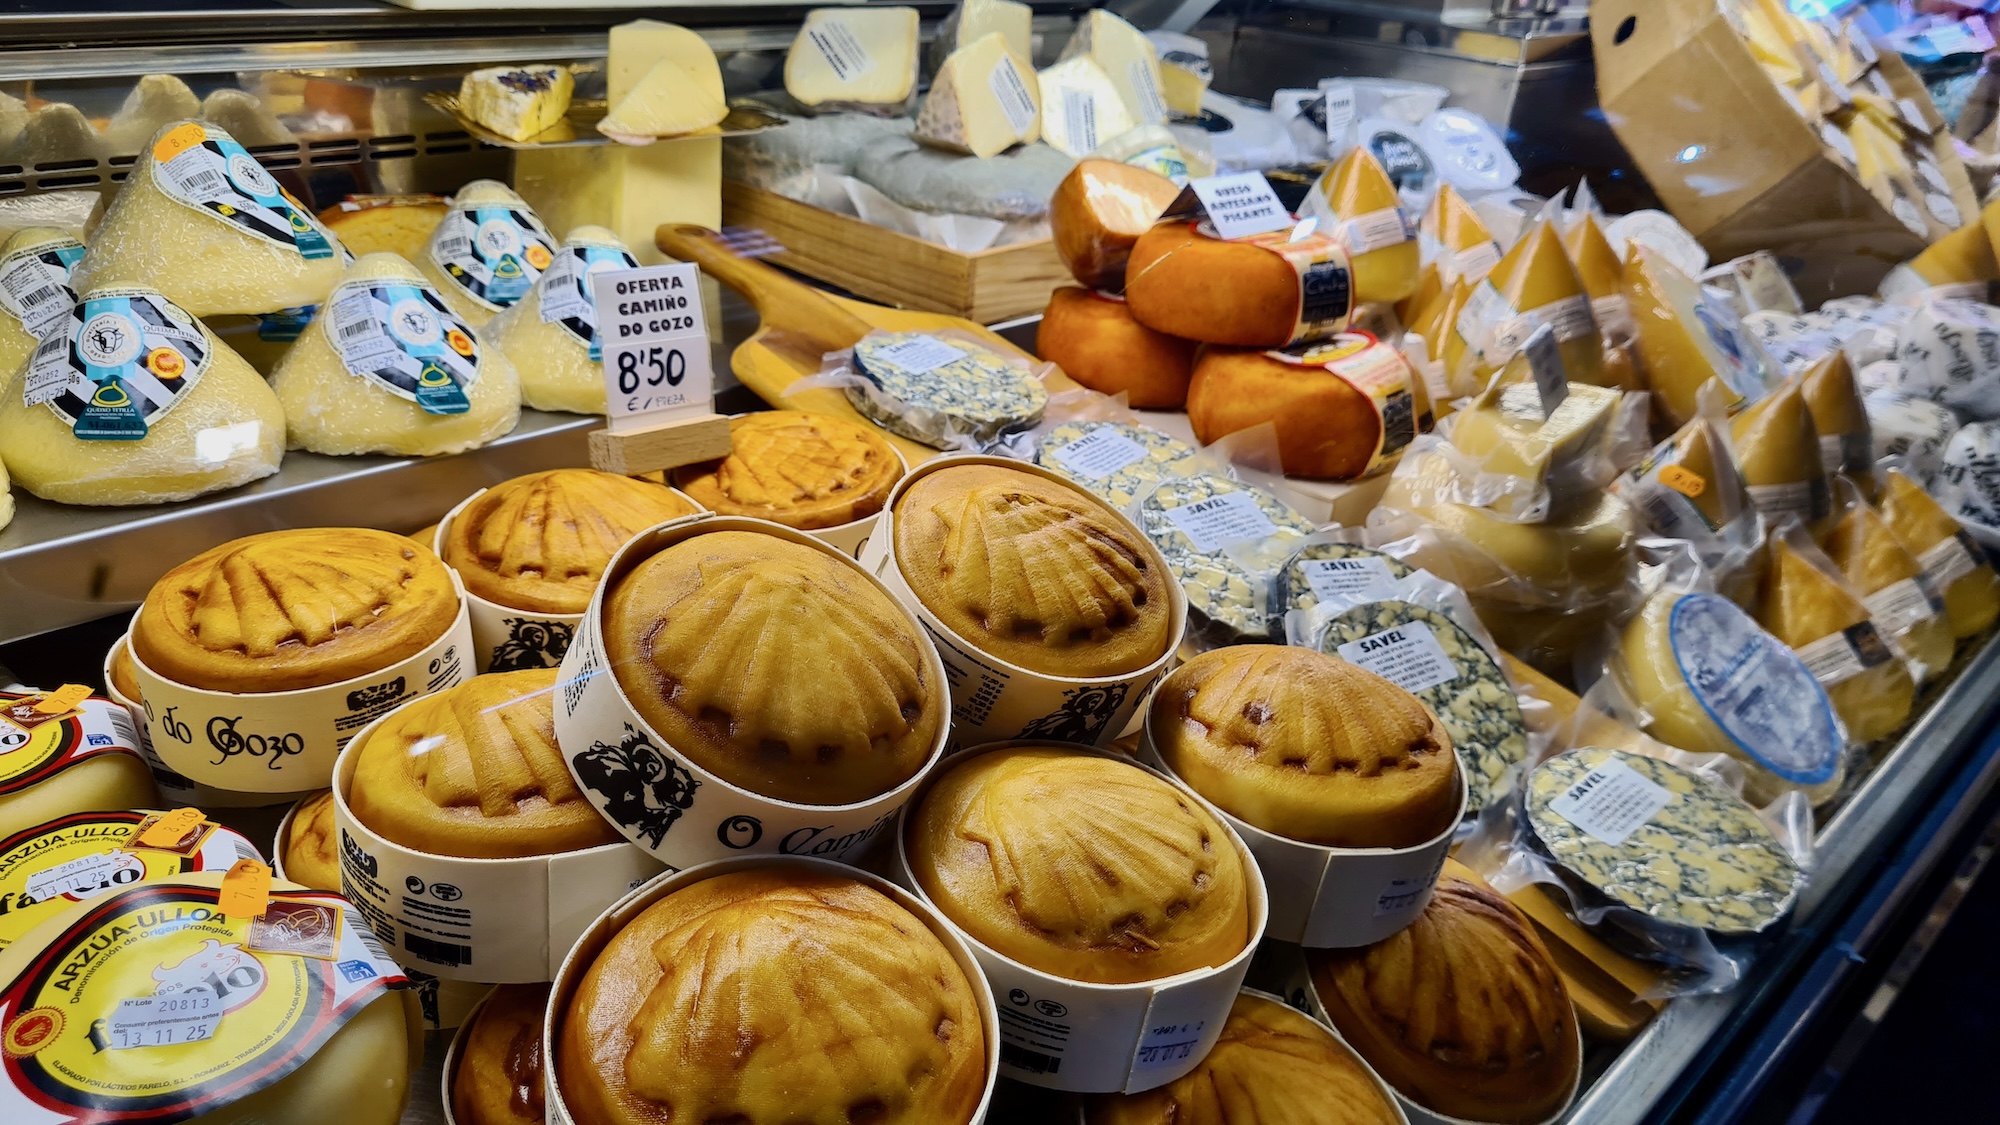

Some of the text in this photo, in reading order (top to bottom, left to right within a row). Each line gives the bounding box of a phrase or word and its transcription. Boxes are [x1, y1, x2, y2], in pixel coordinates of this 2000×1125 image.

[616, 276, 683, 295] OFERTA
[618, 295, 688, 316] CAMIÑO
[143, 325, 176, 334] QUEIXO
[619, 316, 694, 338] DO GOZO
[618, 347, 686, 395] 8'50
[1066, 434, 1099, 452] SAVEL
[1186, 498, 1229, 515] SAVEL
[1320, 560, 1364, 572] SAVEL
[1360, 630, 1406, 653] SAVEL
[162, 707, 193, 744] do
[206, 716, 305, 770] Gozo
[1568, 771, 1606, 801] SAVEL
[70, 837, 100, 845] Origen
[717, 814, 762, 850] O
[56, 868, 97, 881] preferentemente
[60, 856, 100, 872] 20813
[41, 870, 106, 898] 13 11 25
[53, 907, 227, 992] ARZÚA-ULLOA
[70, 922, 234, 1004] Denominación de Origen Protegida
[158, 997, 210, 1013] 20813
[114, 1021, 147, 1029] Consumir
[148, 1016, 200, 1027] preferentemente
[121, 1024, 208, 1047] 13 11 25
[52, 1059, 87, 1084] ELABORADO
[87, 1078, 101, 1088] POR
[101, 1081, 137, 1091] LÁCTEOS
[235, 1035, 273, 1061] TRABANCAS
